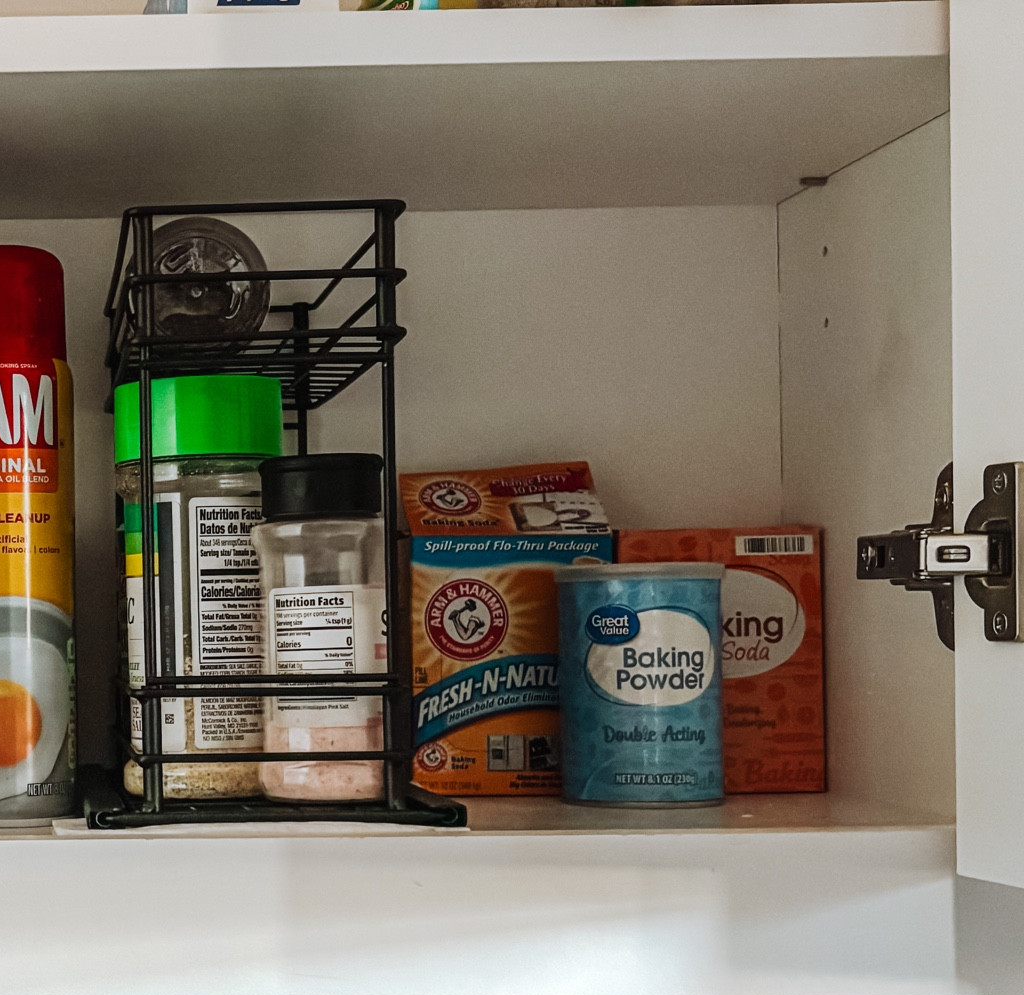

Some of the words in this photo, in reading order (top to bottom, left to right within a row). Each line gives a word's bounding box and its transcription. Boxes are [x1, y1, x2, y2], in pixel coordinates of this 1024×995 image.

[528, 484, 556, 493] Days
[200, 508, 240, 520] Nutrition
[200, 523, 226, 534] Datos
[228, 523, 238, 534] de
[426, 541, 489, 553] Spill-proof
[493, 541, 544, 551] Flo-Thru
[548, 541, 599, 553] Package
[200, 549, 219, 558] Serving
[276, 597, 316, 608] Nutrition
[318, 597, 345, 606] Facts
[430, 596, 449, 628] ARM
[446, 588, 458, 600] &
[459, 584, 504, 627] HAMMER
[592, 614, 629, 627] Great
[600, 626, 629, 635] Value
[722, 611, 783, 643] king
[277, 640, 302, 649] Calories
[346, 636, 353, 646] 0
[722, 640, 770, 661] Soda
[623, 647, 704, 673] Baking
[617, 670, 705, 691] Powder
[418, 663, 560, 728] FRESH-N-NATU
[449, 698, 495, 722] Household
[497, 694, 520, 706] Odor
[603, 725, 657, 743] Double
[661, 725, 706, 744] Acting
[616, 774, 632, 784] NET
[632, 774, 646, 784] WT
[662, 774, 673, 784] OZ
[28, 784, 41, 796] NET
[43, 784, 53, 795] WT
